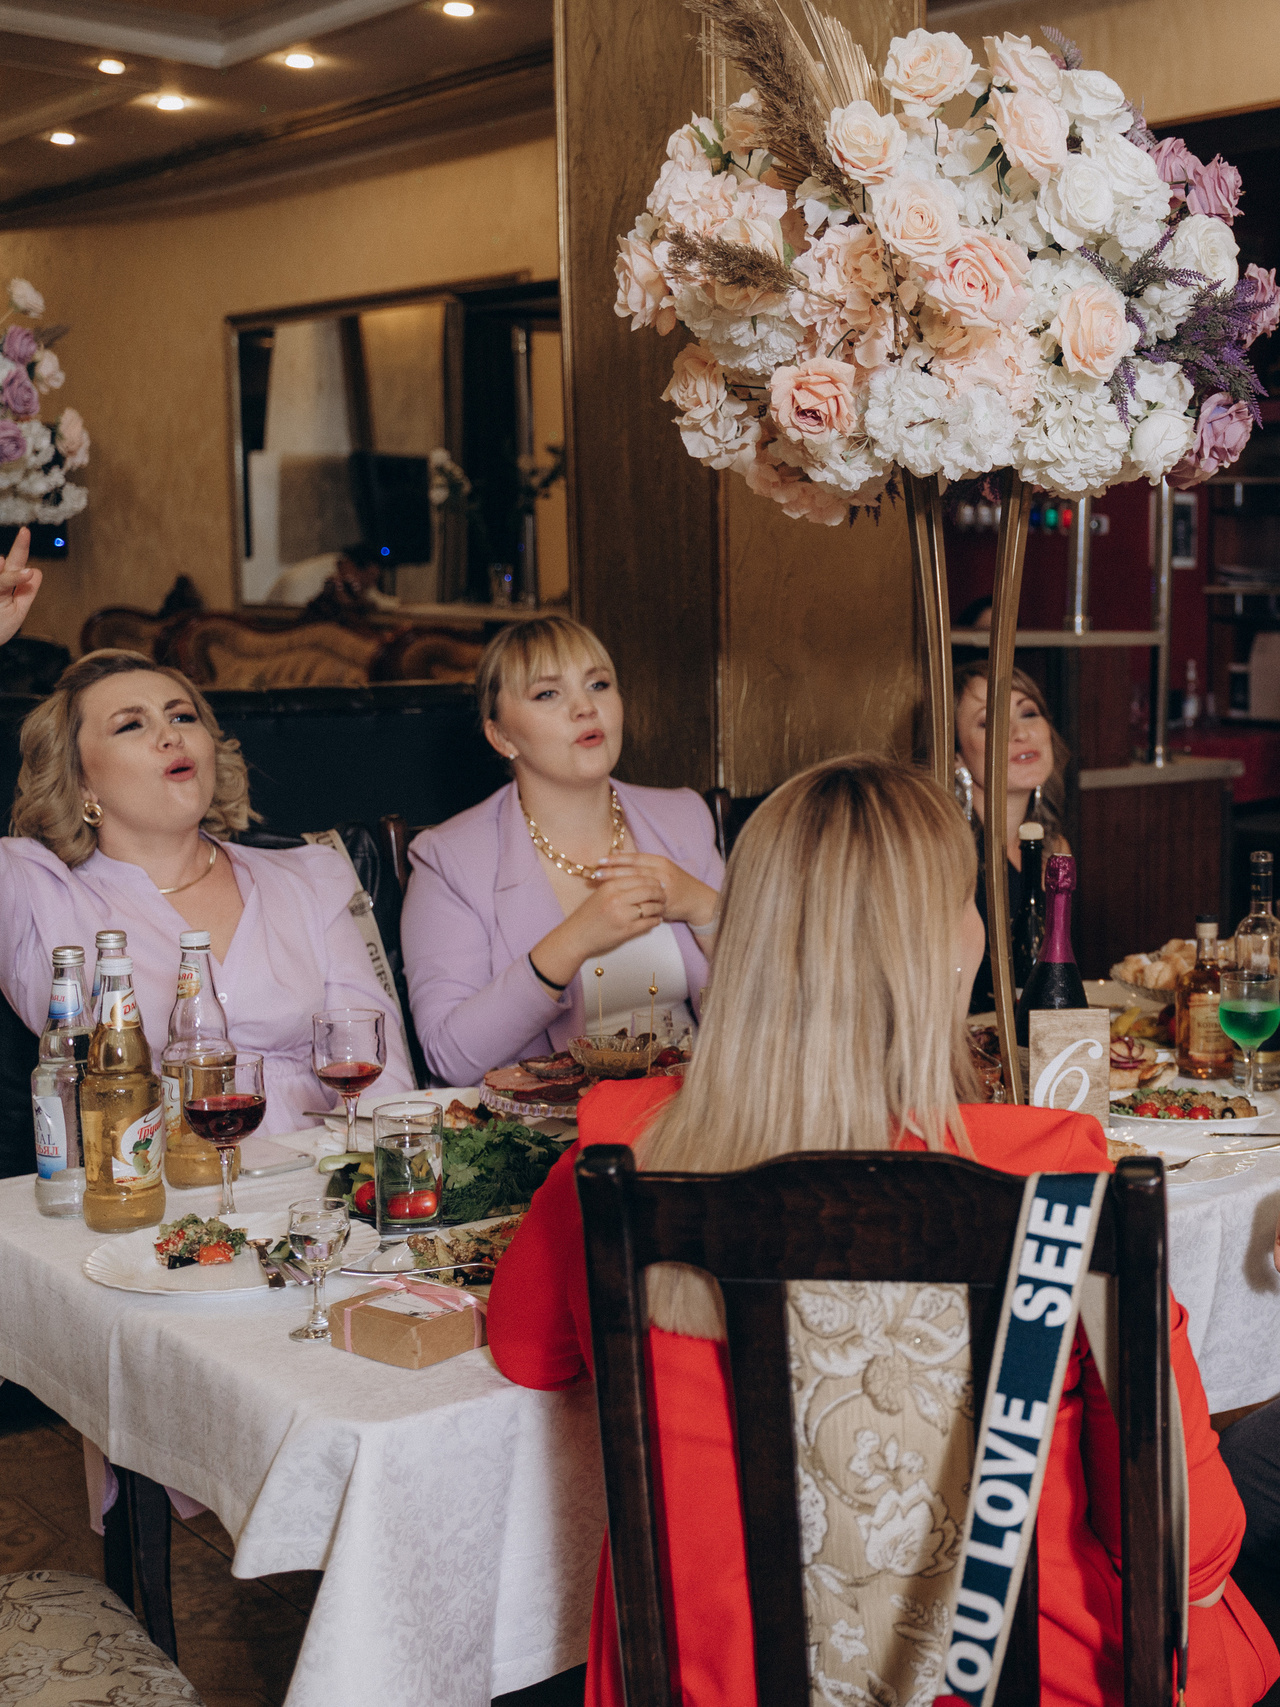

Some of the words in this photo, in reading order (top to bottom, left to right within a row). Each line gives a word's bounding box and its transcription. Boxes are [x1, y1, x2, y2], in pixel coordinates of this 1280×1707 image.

[1034, 1039, 1103, 1111] 6
[1011, 1197, 1092, 1327] SEE
[966, 1392, 1048, 1568] LOVE
[942, 1588, 1004, 1695] OU
